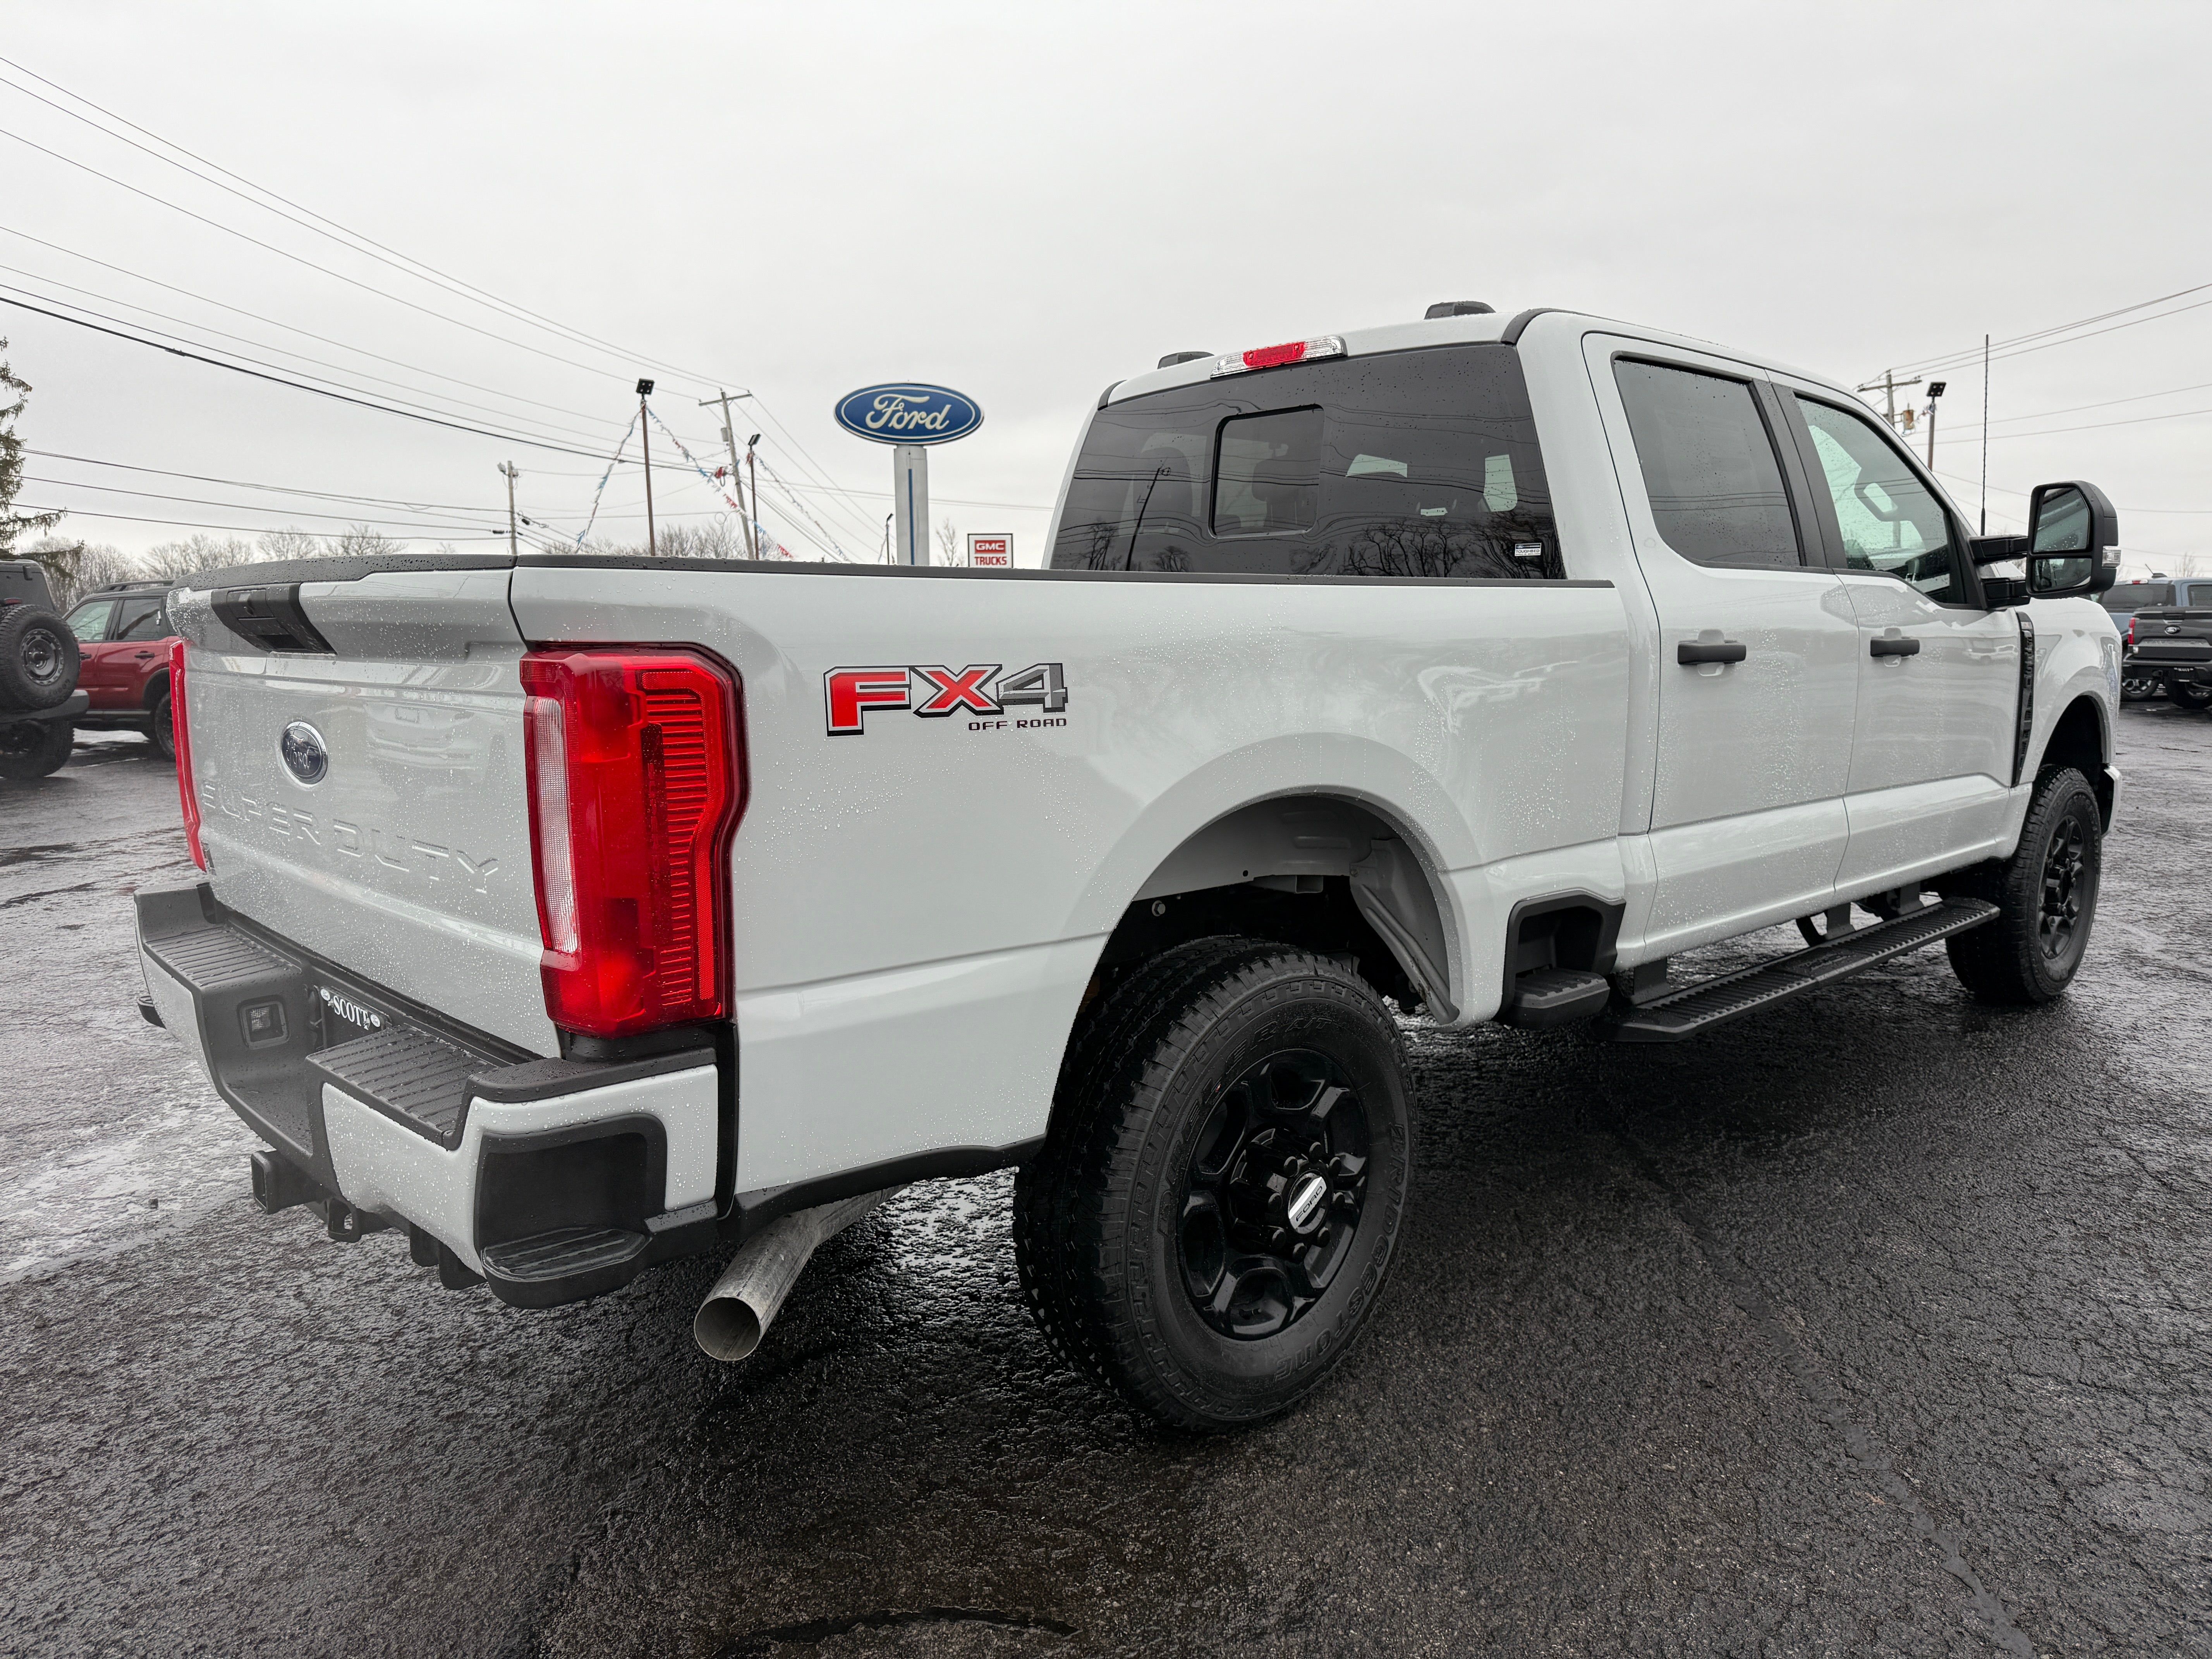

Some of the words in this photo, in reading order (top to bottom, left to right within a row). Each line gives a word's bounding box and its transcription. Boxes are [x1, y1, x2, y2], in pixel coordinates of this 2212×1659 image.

[865, 393, 952, 430] Ford
[974, 556, 1007, 566] TRUCKS
[823, 663, 1068, 737] FX4
[968, 721, 1008, 731] OFF
[1016, 718, 1067, 729] ROAD
[285, 733, 311, 770] Ford
[201, 778, 321, 846] SUPER
[332, 817, 500, 895] DUTY
[333, 995, 369, 1030] SCOTT
[1296, 1185, 1322, 1222] FORD
[1274, 1123, 1405, 1383] BRIDGESTONE
